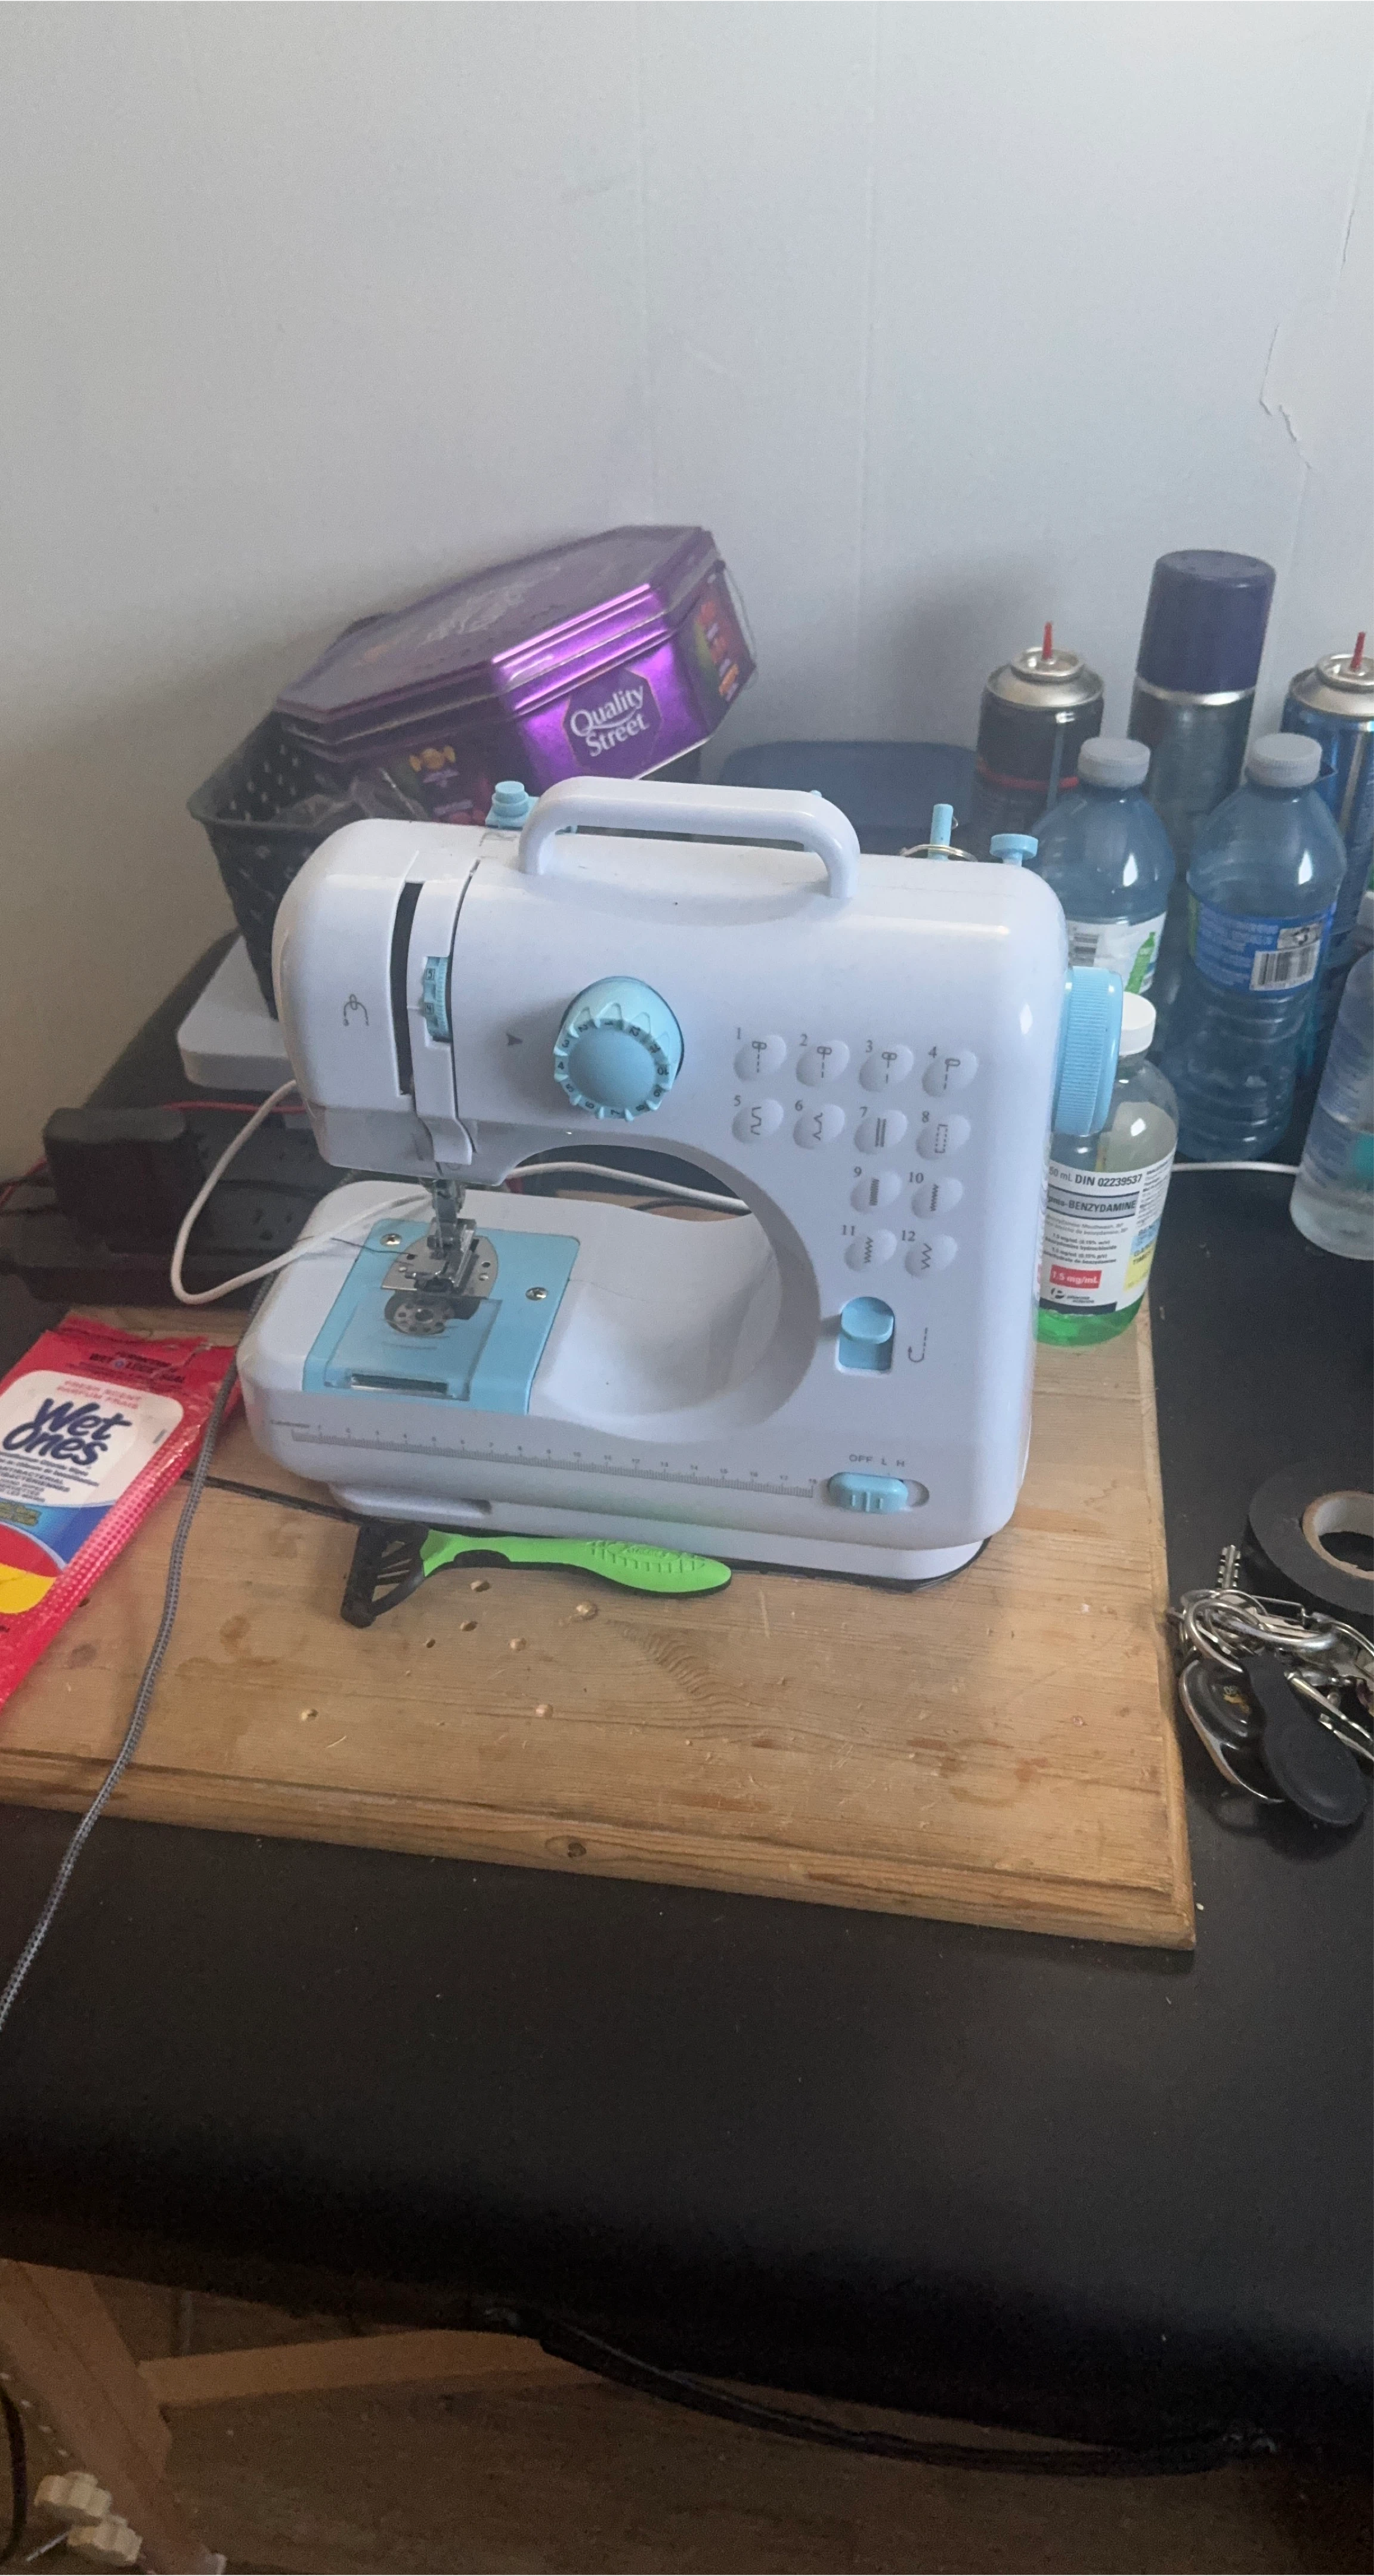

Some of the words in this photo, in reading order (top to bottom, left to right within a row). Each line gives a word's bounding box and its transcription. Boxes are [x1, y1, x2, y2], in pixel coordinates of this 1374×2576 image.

[570, 686, 643, 737] Quality
[586, 713, 650, 757] Street
[577, 1024, 589, 1033] 2
[629, 1026, 642, 1037] 12
[562, 1039, 570, 1048] 3
[736, 1027, 741, 1040] 1
[799, 1033, 808, 1046] 2
[865, 1039, 873, 1053] 3
[928, 1046, 937, 1058] 4
[558, 1061, 565, 1070] 4
[657, 1066, 670, 1076] 10
[566, 1083, 574, 1092] 5
[653, 1088, 663, 1097] 9
[734, 1094, 741, 1107] 5
[795, 1099, 804, 1111] 6
[859, 1106, 868, 1118] 7
[921, 1110, 930, 1123] 8
[853, 1166, 862, 1178] 9
[908, 1171, 924, 1184] 10
[1060, 1172, 1073, 1182] mL
[1075, 1174, 1096, 1187] DIN
[1097, 1173, 1143, 1187] 02239537
[842, 1224, 855, 1236] 11
[901, 1230, 916, 1242] 12
[1052, 1270, 1065, 1281] 1.5
[1066, 1275, 1098, 1285] mg/mL
[33, 1398, 133, 1440] Wet
[2, 1420, 109, 1465] Ones
[849, 1454, 873, 1462] OFF
